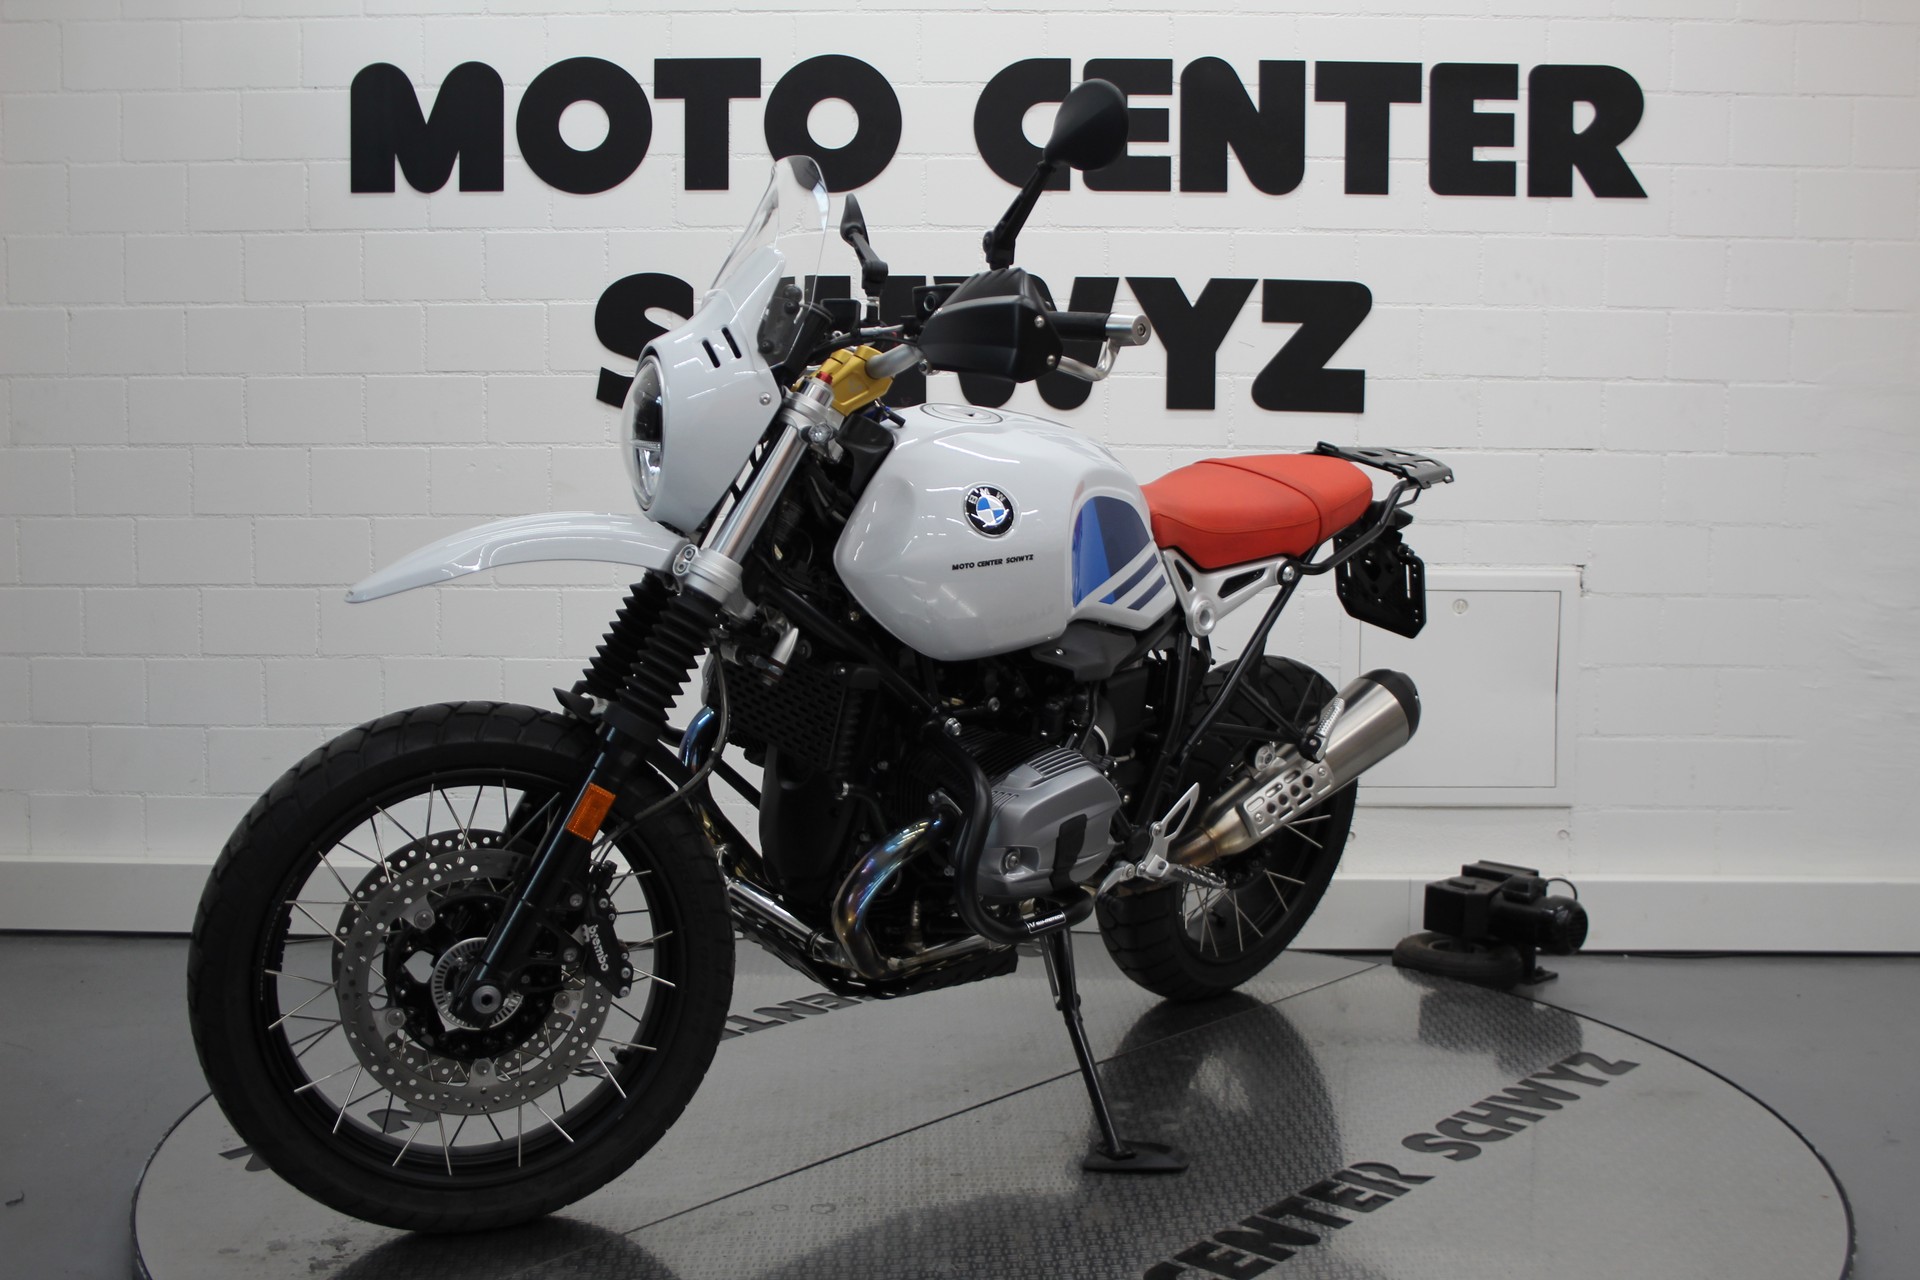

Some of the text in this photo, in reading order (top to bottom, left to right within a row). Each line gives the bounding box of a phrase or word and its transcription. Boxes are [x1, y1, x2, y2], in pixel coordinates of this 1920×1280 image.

[350, 54, 1648, 199] MOTO CENTER
[951, 562, 975, 571] MOTO
[977, 558, 1003, 568] CENTER
[588, 924, 609, 972] brembo
[1401, 1051, 1641, 1162] SCHWYZ
